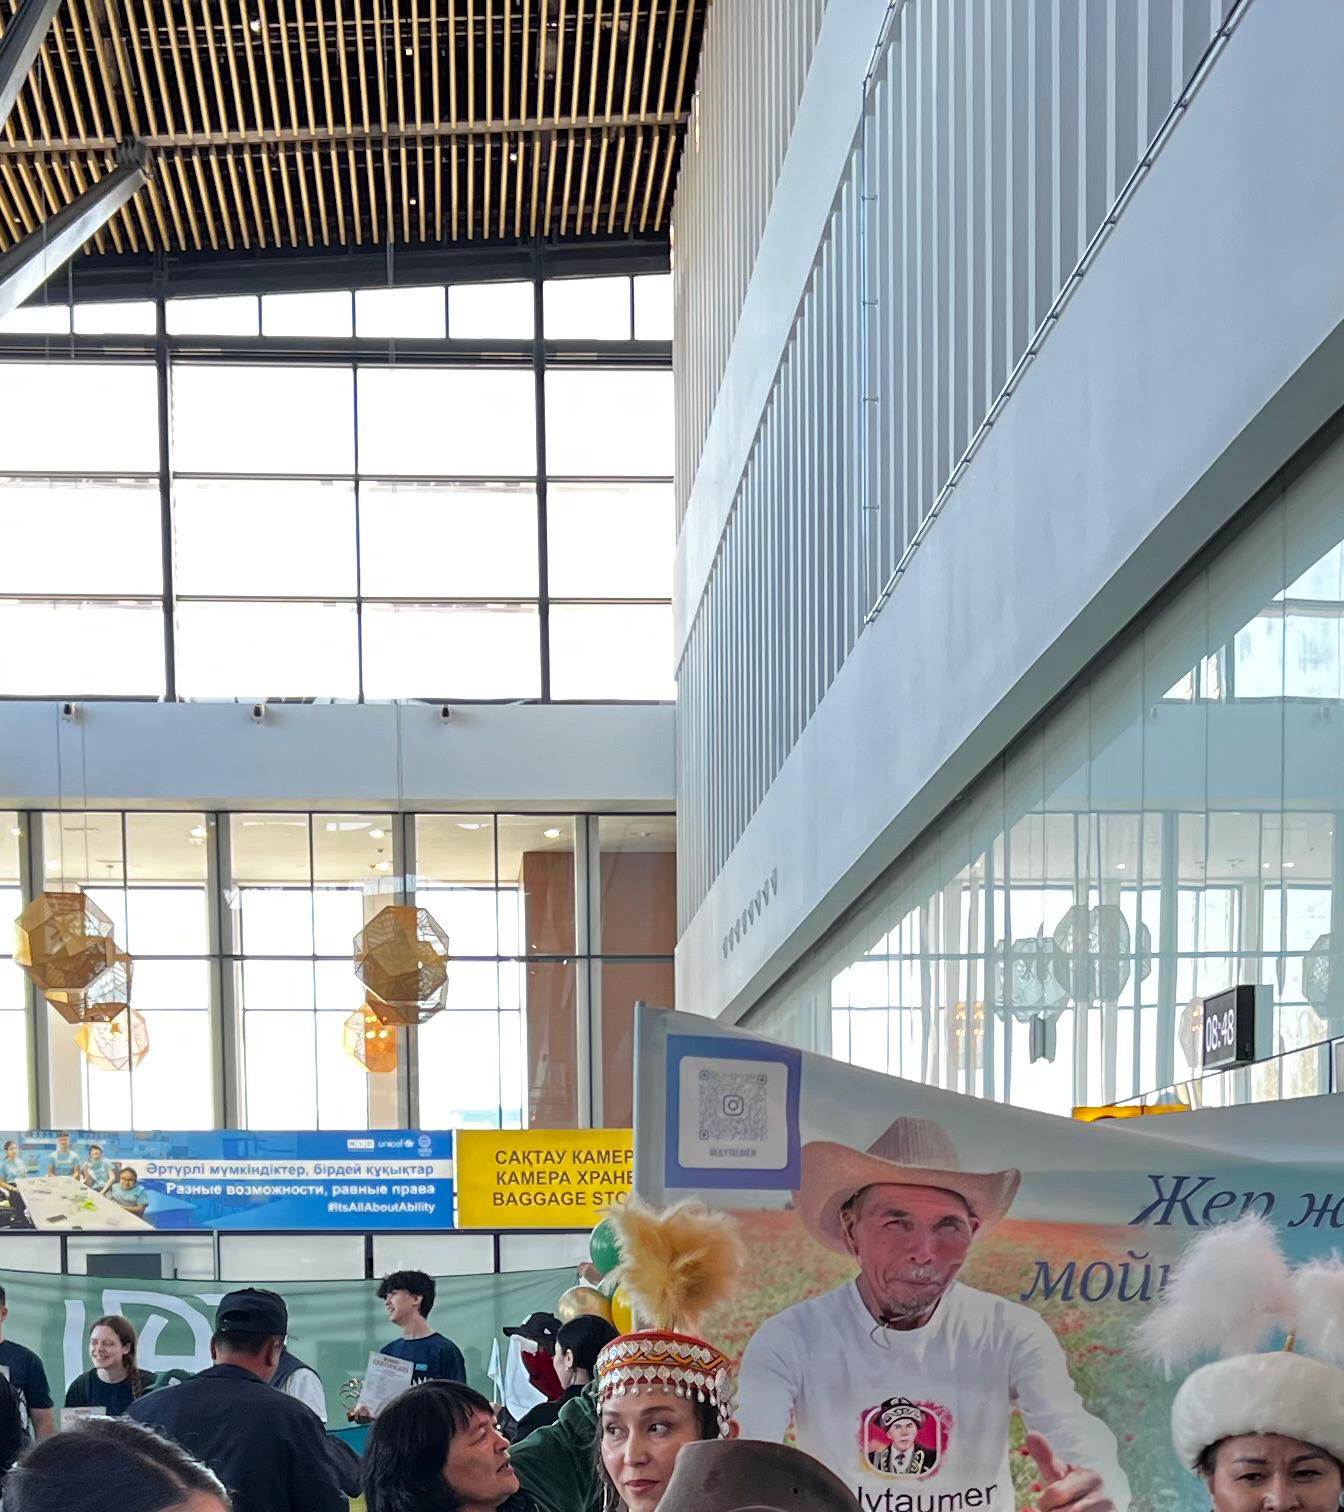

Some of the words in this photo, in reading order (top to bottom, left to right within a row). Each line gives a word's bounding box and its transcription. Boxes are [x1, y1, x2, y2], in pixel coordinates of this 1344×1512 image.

[1205, 1008, 1235, 1053] 08:48
[495, 1149, 567, 1167] САҚТАУ
[572, 1149, 634, 1165] КАМЕР
[145, 1161, 205, 1177] Әртүрлі
[313, 1161, 362, 1177] бірдей
[496, 1170, 572, 1185] КАМЕРА
[577, 1170, 633, 1186] ХРАНЕ
[166, 1183, 222, 1196] Разные
[226, 1183, 328, 1198] возможности,
[332, 1184, 388, 1198] равные
[391, 1184, 436, 1198] права
[492, 1191, 587, 1207] BAGGAGE
[592, 1191, 628, 1206] STO
[327, 1201, 436, 1215] #ItsAllAboutAbility
